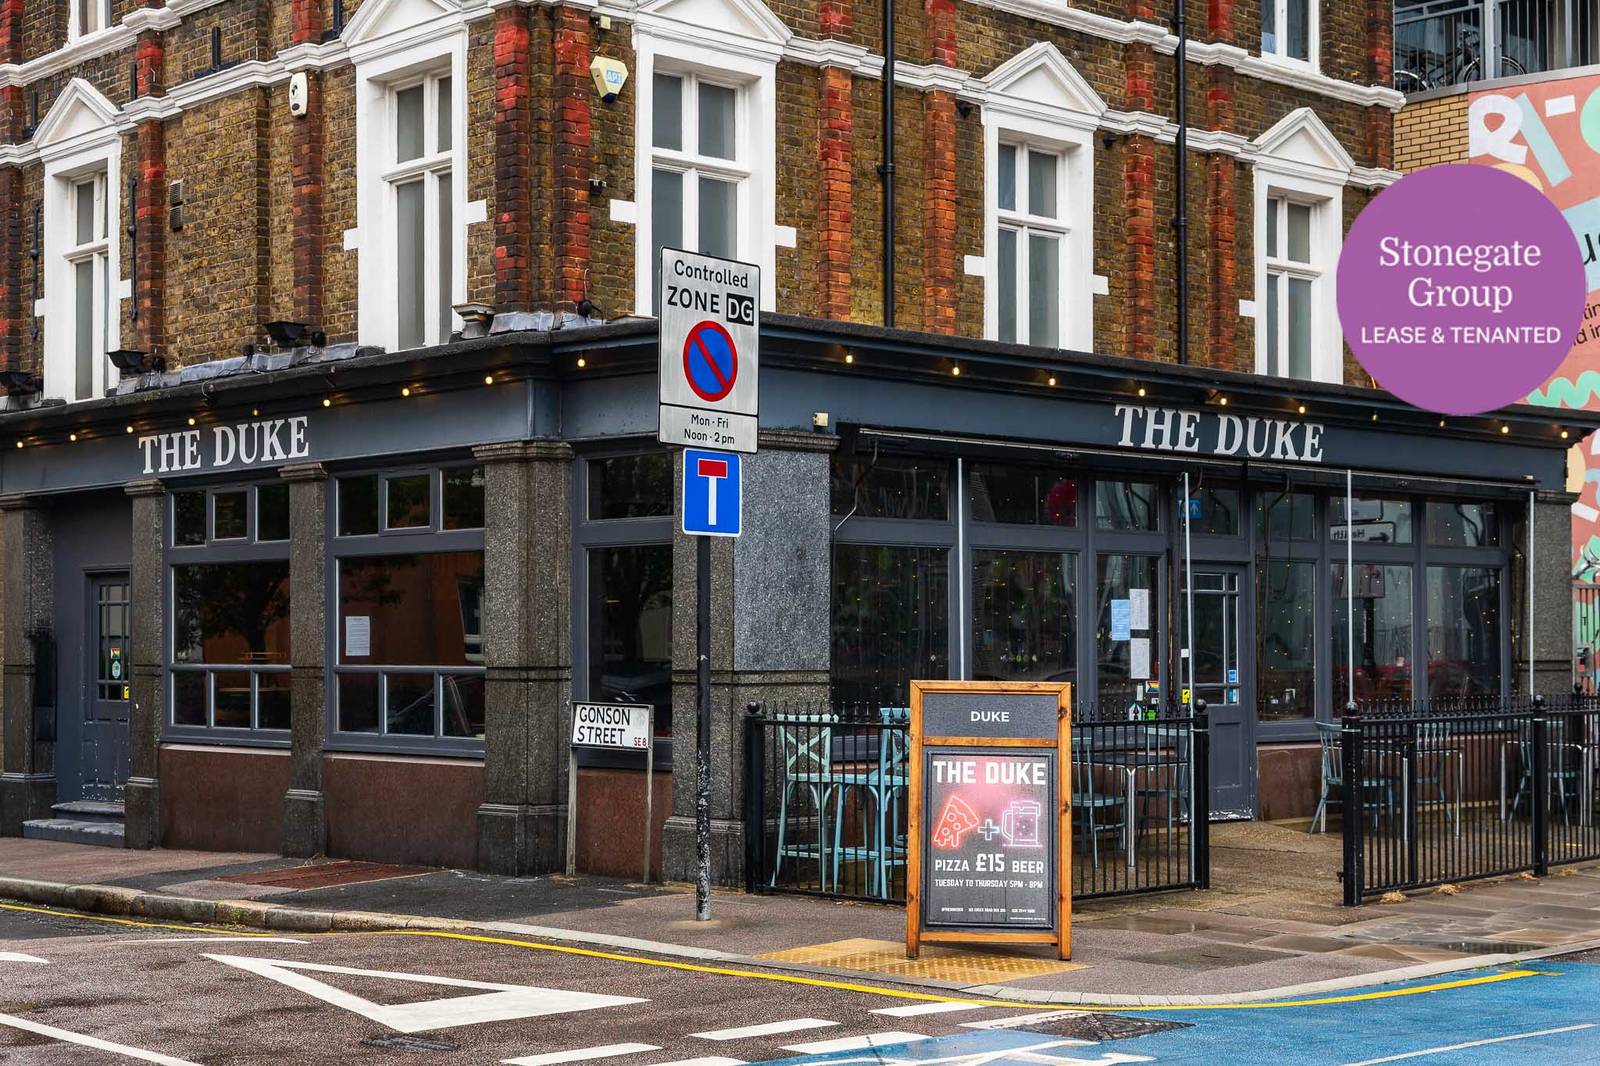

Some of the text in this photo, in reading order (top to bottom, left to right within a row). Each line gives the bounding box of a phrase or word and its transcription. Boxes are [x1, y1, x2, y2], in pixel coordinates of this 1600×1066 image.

[674, 260, 748, 288] Controlled
[667, 285, 754, 322] ZONE DG
[691, 414, 710, 427] Mon
[717, 417, 729, 429] Fri
[684, 428, 708, 441] Noon
[1114, 404, 1324, 462] THE DUKE
[138, 416, 309, 474] THE DUKE
[579, 706, 631, 726] GONSON
[970, 711, 1010, 723] DUKE
[577, 725, 626, 745] STREET
[933, 761, 1047, 786] THE DUKE
[935, 853, 1044, 874] PIZZA £15 BEER
[935, 878, 964, 888] TUESDAY
[965, 879, 974, 888] TO
[975, 879, 1009, 889] THURSDAY
